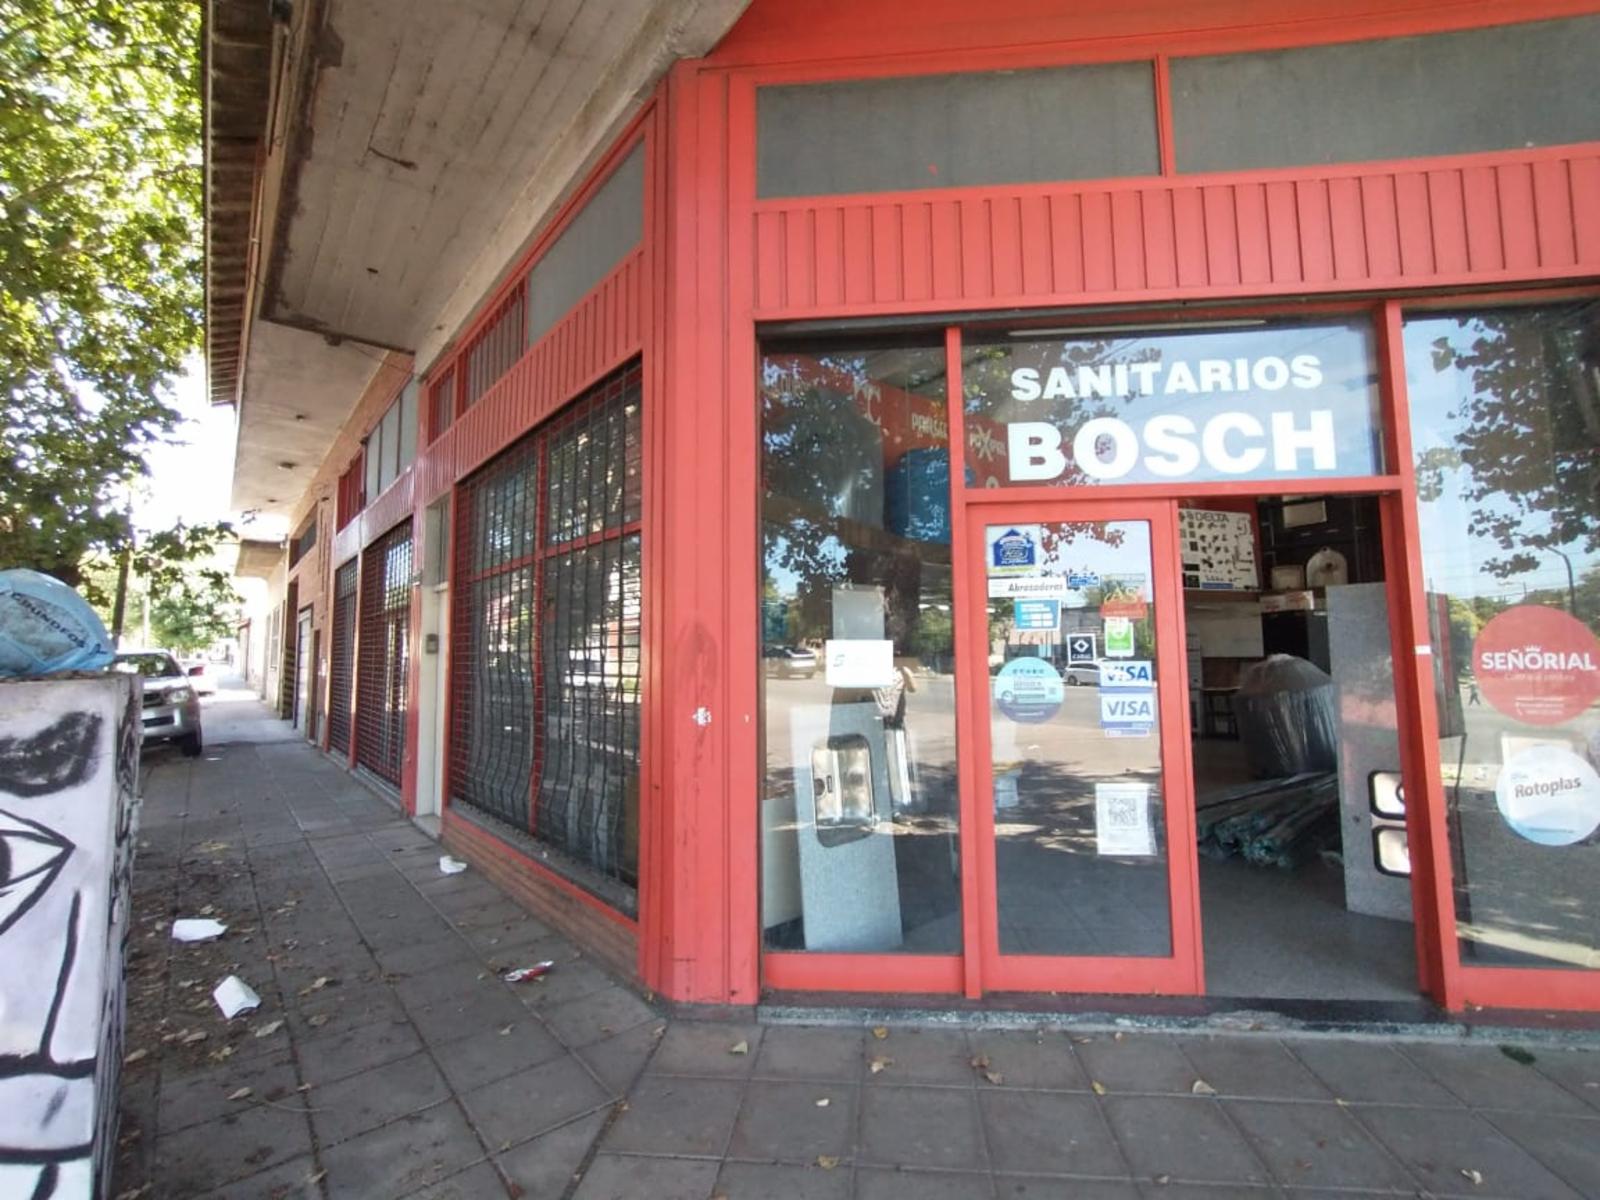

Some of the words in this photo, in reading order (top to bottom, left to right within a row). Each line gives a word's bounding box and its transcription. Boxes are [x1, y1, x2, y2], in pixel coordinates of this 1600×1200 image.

[1011, 355, 1323, 401] SANITARIOS
[1007, 410, 1336, 481] BOSCH
[1195, 513, 1230, 523] DELTA
[1481, 648, 1597, 670] SEÑORIAL
[1107, 701, 1151, 716] VISA
[1514, 777, 1582, 797] Rotoplas
